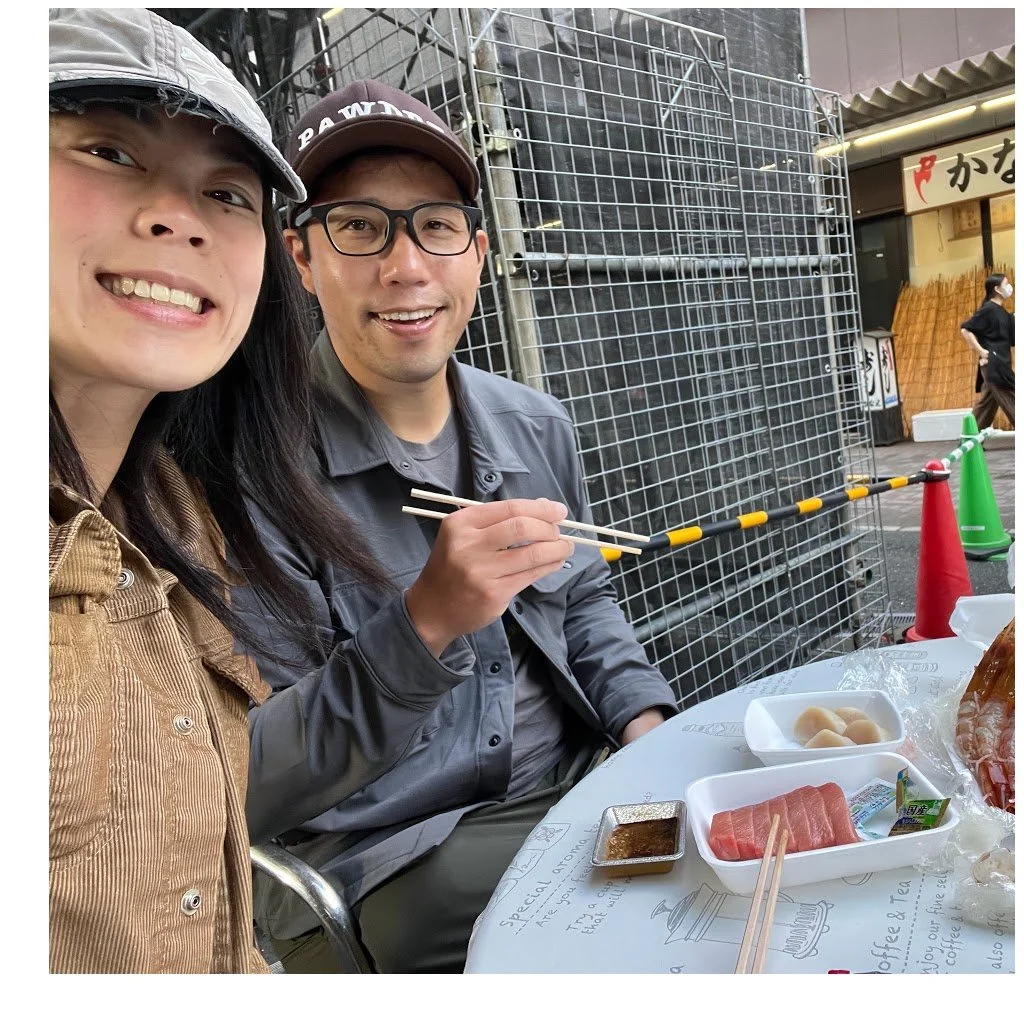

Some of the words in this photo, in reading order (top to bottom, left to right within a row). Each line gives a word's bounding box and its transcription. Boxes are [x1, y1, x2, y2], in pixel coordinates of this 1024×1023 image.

[907, 805, 928, 816] 国産
[500, 879, 552, 928] Special
[551, 837, 591, 875] aroma
[889, 880, 912, 905] Tea
[535, 909, 558, 927] Are
[555, 886, 577, 907] you
[565, 912, 594, 933] Try
[588, 902, 598, 910] a
[596, 879, 619, 900] cup
[580, 912, 607, 936] that
[606, 887, 627, 909] will
[886, 910, 906, 921] &
[926, 893, 946, 916] fine
[928, 920, 941, 941] our
[950, 915, 964, 923] &
[986, 911, 1009, 937] offe
[870, 925, 903, 972] offee
[917, 946, 944, 974] njoy
[941, 925, 964, 967] coffee
[986, 941, 1004, 970] also
